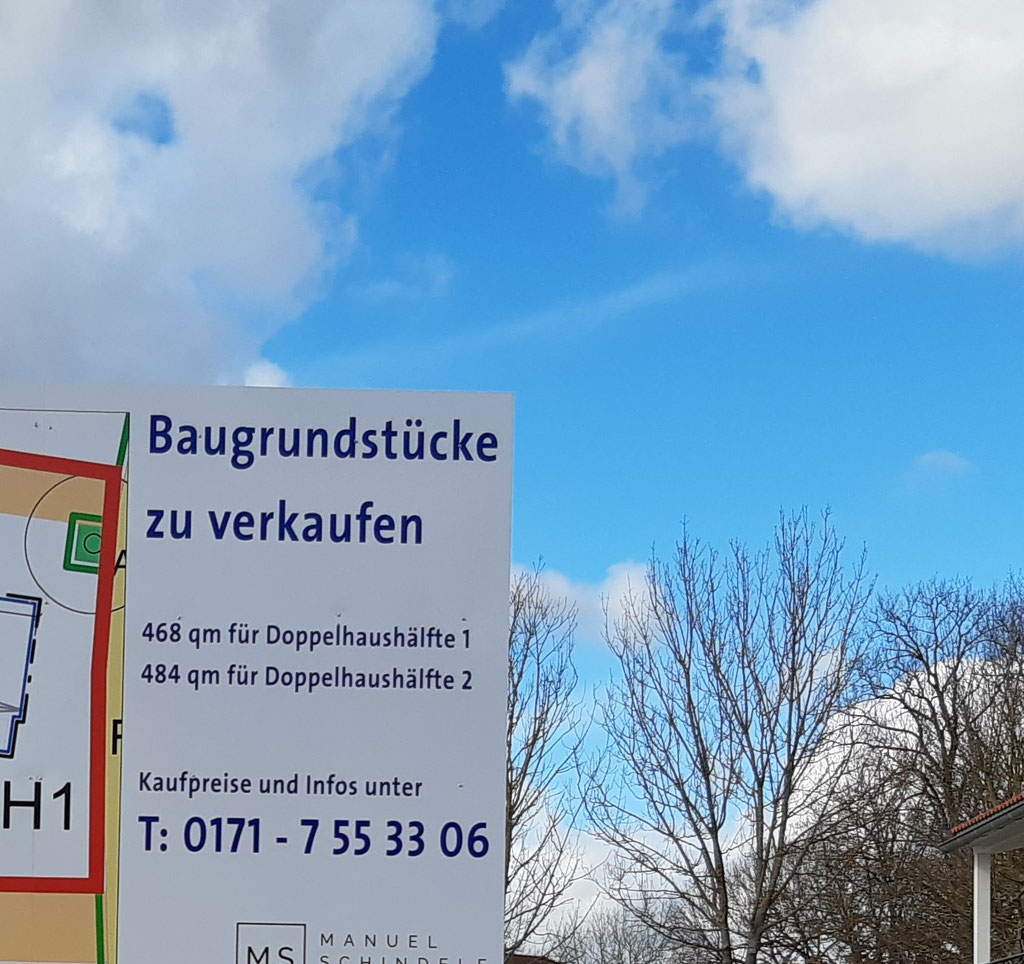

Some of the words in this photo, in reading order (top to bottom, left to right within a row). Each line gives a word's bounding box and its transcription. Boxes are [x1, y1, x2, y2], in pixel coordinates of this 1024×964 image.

[149, 414, 499, 470] Baugrundstücke
[146, 508, 193, 540] zu
[208, 499, 423, 544] verkaufen
[142, 622, 182, 643] 468
[188, 628, 221, 649] qm
[228, 623, 259, 645] für
[266, 624, 456, 652] Doppelhaushälfte
[462, 629, 471, 649] 1
[141, 664, 181, 684] 484
[187, 670, 220, 691] qm
[227, 664, 258, 686] für
[265, 666, 455, 693] Doppelhaushälfte
[461, 670, 473, 690] 2
[139, 771, 252, 799] Kaufpreise
[259, 773, 299, 794] und
[306, 774, 358, 796] Infos
[365, 777, 423, 797] unter
[138, 816, 168, 852] T:
[184, 816, 261, 854] 0171
[300, 818, 320, 855] 7
[332, 819, 372, 856] 55
[385, 820, 426, 857] 33
[440, 821, 490, 858] 06
[320, 933, 438, 949] MANUEL
